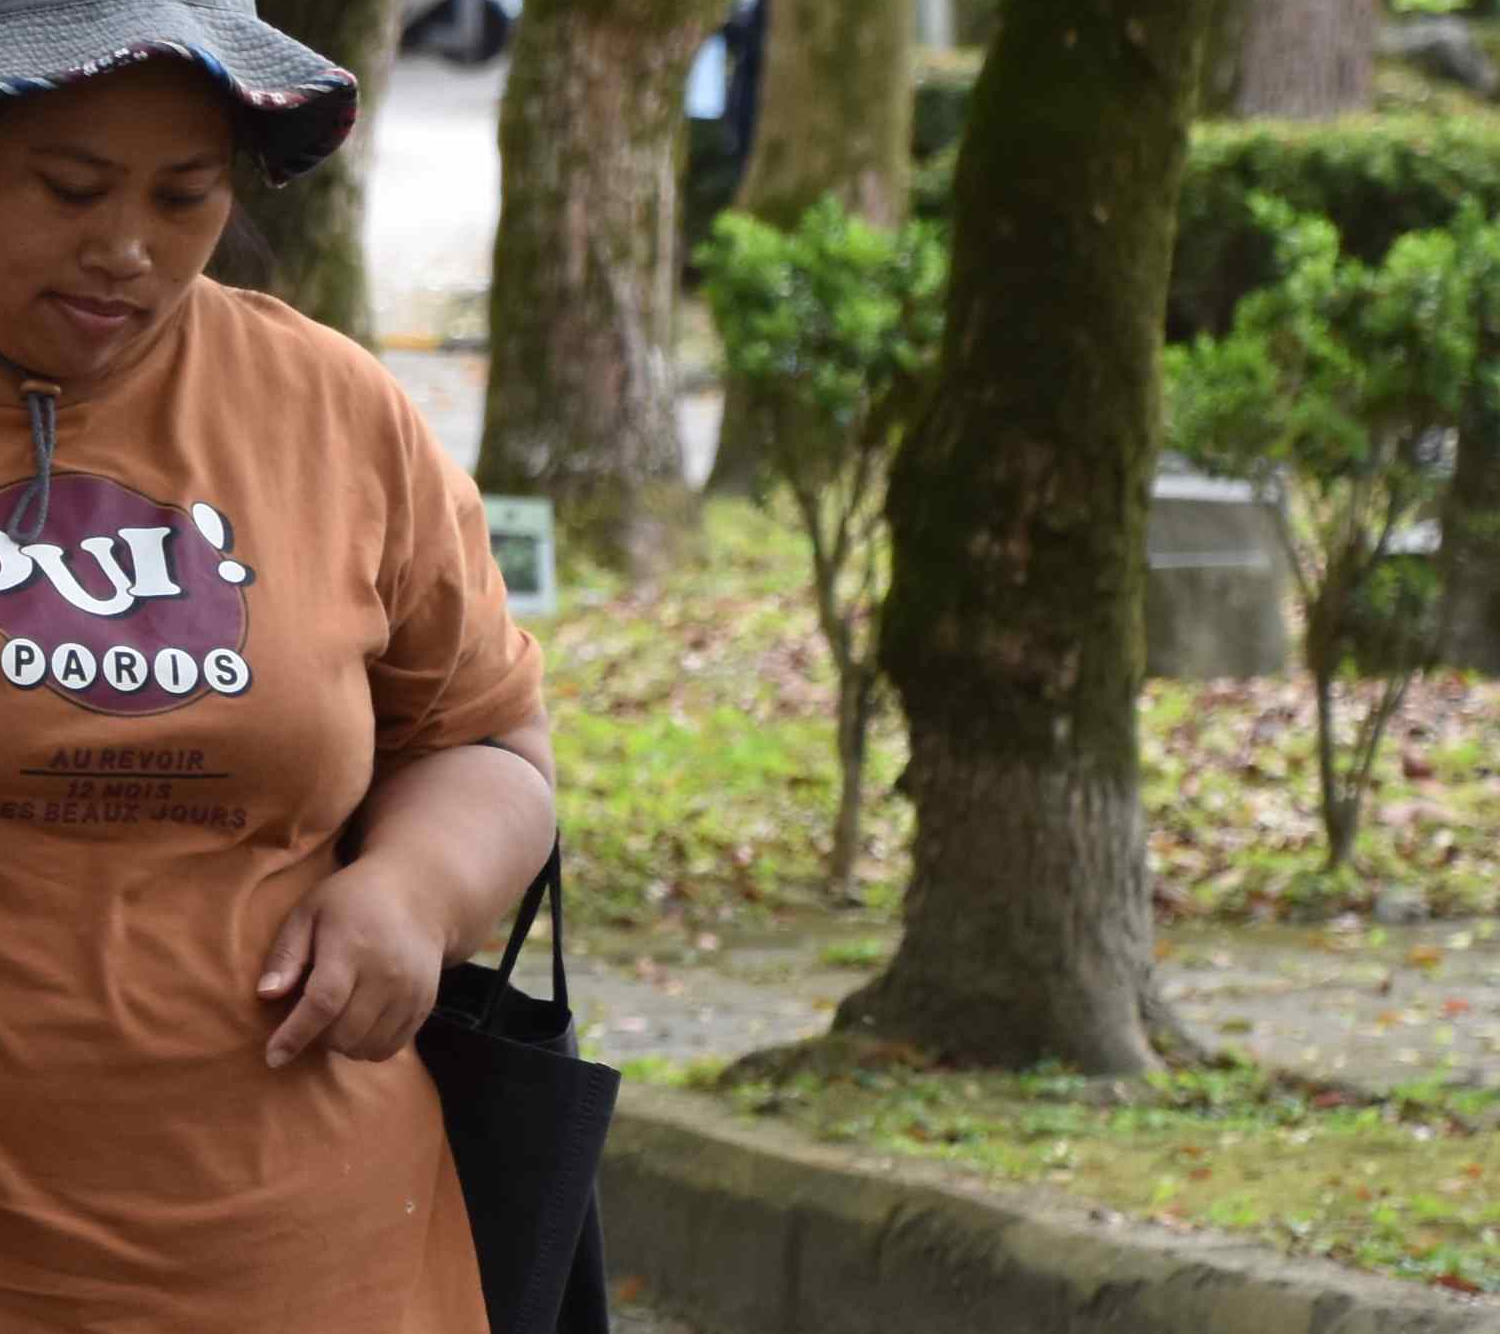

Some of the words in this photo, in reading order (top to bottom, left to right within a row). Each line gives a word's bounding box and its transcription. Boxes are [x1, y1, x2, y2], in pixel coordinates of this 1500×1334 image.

[9, 641, 242, 688] PARIS
[48, 747, 92, 770] AU
[98, 747, 205, 770] REVOIR
[67, 779, 96, 800] 12
[101, 780, 173, 800] MOIS
[43, 801, 141, 824] BEAUX
[149, 803, 248, 829] JOURS
